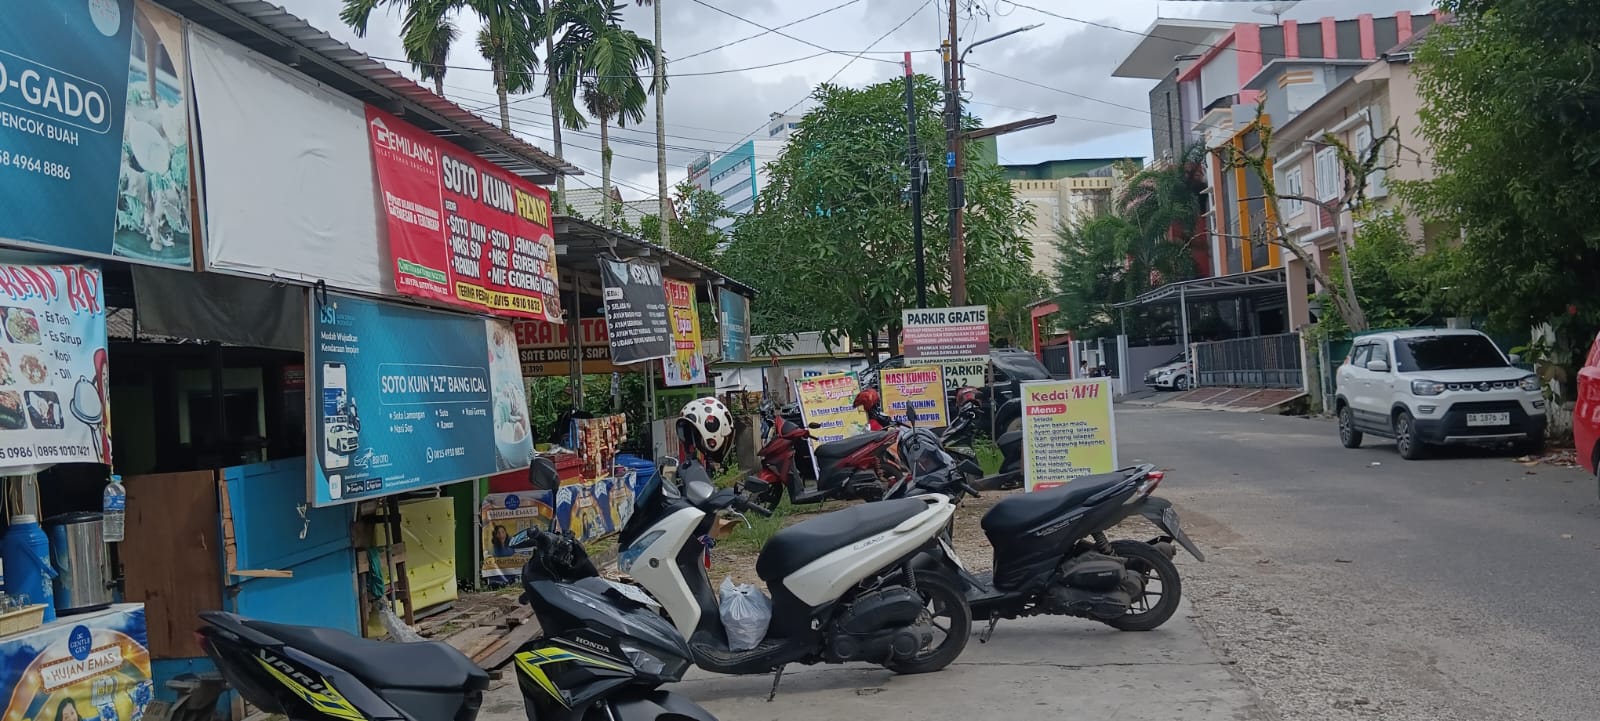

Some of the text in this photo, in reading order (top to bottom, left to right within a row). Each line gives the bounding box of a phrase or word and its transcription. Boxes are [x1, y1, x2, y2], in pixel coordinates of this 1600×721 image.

[0, 113, 79, 146] ENCOK BUAH
[13, 153, 41, 173] 4964
[44, 159, 71, 180] 8886
[442, 155, 479, 200] SOTO
[482, 173, 515, 213] KUIN
[449, 215, 469, 237] SOTO
[491, 229, 510, 250] SOTO
[512, 253, 540, 274] GORENG
[491, 267, 506, 285] MIE
[512, 296, 526, 310] 4910
[45, 311, 70, 326] Es Teh
[907, 310, 986, 325] PARKIR GRATIS
[48, 331, 82, 347] Es Sirup
[54, 349, 71, 364] Kopi
[521, 350, 545, 361] SATE
[586, 348, 608, 359] SAPI
[885, 371, 937, 384] NASI KUNING
[945, 365, 983, 377] PARKIR
[381, 375, 407, 393] SOTO
[408, 375, 430, 393] KUIN
[448, 376, 470, 393] BANG
[471, 377, 487, 393] ICAL
[962, 378, 968, 388] 2
[1031, 384, 1100, 402] Kedai MH
[1031, 406, 1057, 415] Menu
[7, 447, 33, 459] 0986
[37, 445, 58, 457] 0895
[59, 444, 77, 457] 1010
[575, 636, 610, 653] HONDA
[51, 652, 116, 681] HUJAN EMAS
